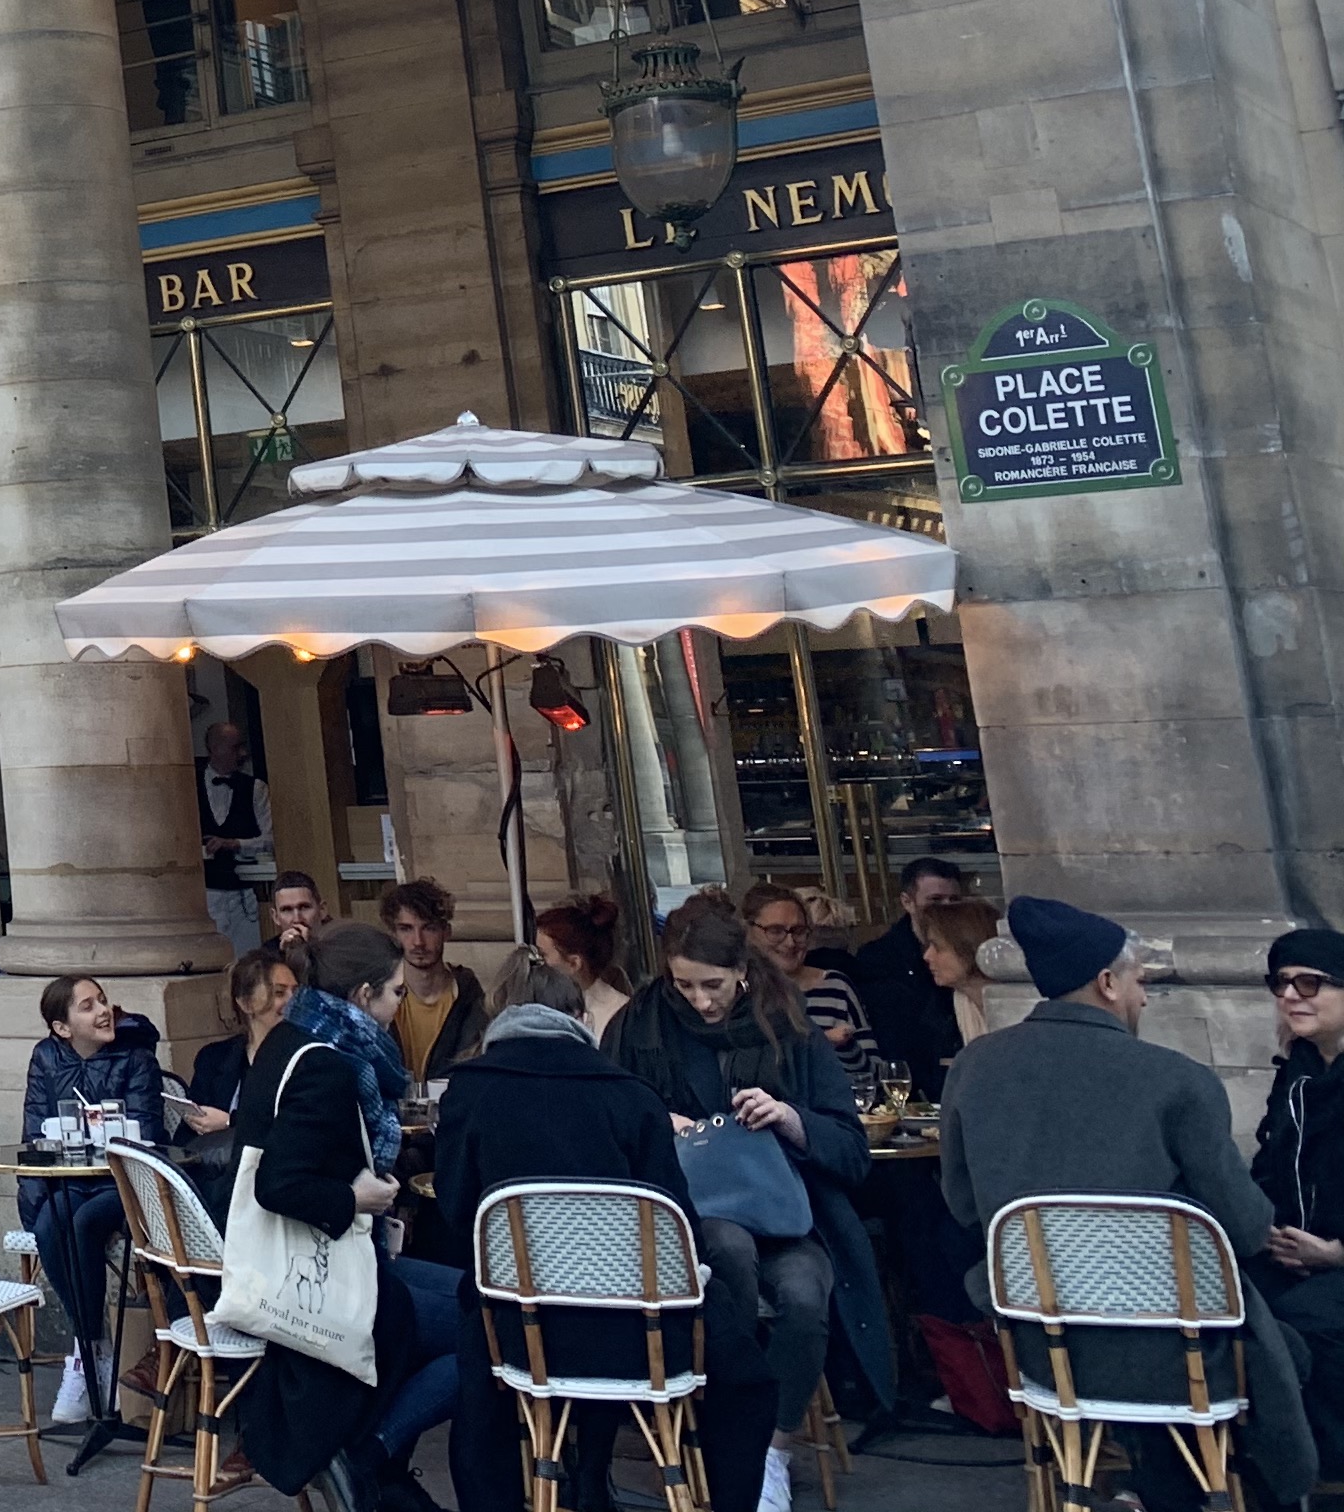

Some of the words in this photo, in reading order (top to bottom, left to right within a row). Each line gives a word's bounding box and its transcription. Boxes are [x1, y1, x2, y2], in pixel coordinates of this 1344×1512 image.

[620, 206, 697, 251] L
[742, 170, 893, 232] NEM
[158, 262, 260, 312] BAR
[994, 364, 1106, 402] PLACE
[979, 395, 1136, 437] COLETTE
[977, 438, 1088, 459] SIDONIE-GABRIELLE
[1092, 432, 1146, 448] COLETTE
[1030, 454, 1055, 466] 1873
[1071, 451, 1096, 463] 1954
[259, 1298, 290, 1320] Royal
[291, 1316, 310, 1329] par
[312, 1324, 345, 1342] nature
